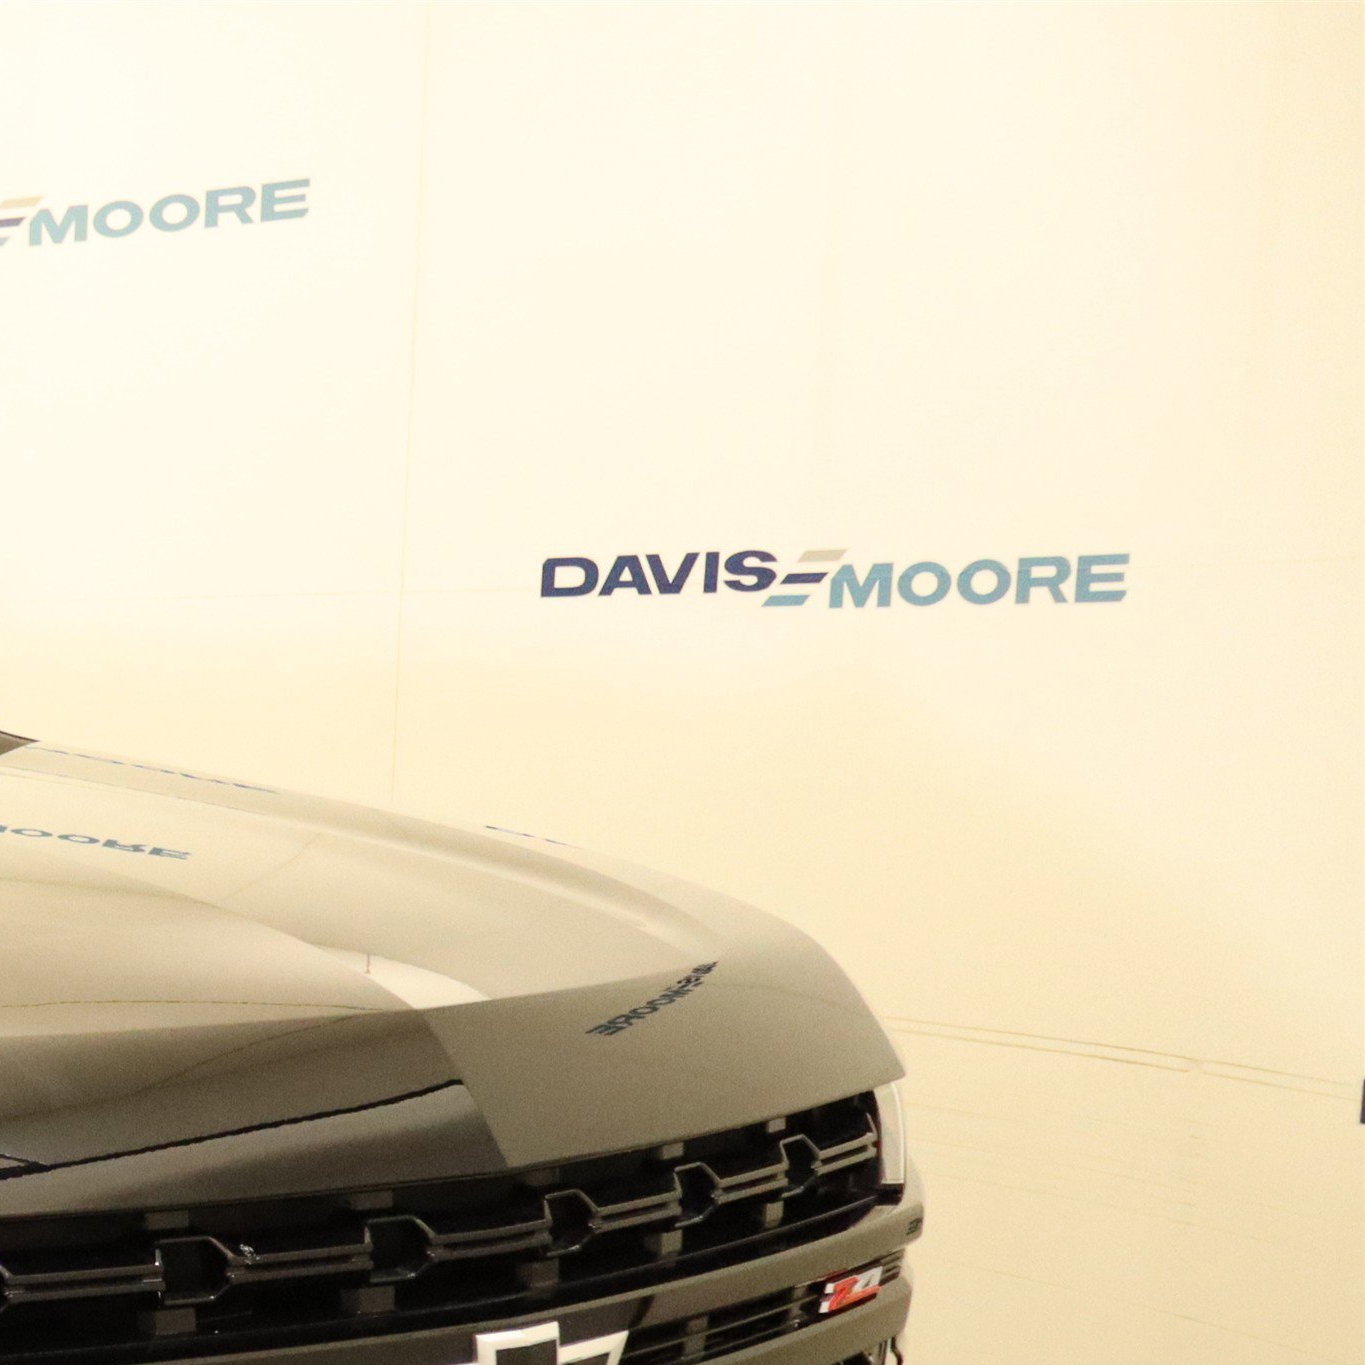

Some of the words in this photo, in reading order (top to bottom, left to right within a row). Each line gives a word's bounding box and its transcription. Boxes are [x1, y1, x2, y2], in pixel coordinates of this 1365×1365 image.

[29, 178, 310, 247] MOORE
[540, 549, 780, 598] DAVIS
[828, 553, 1130, 608] MOORE
